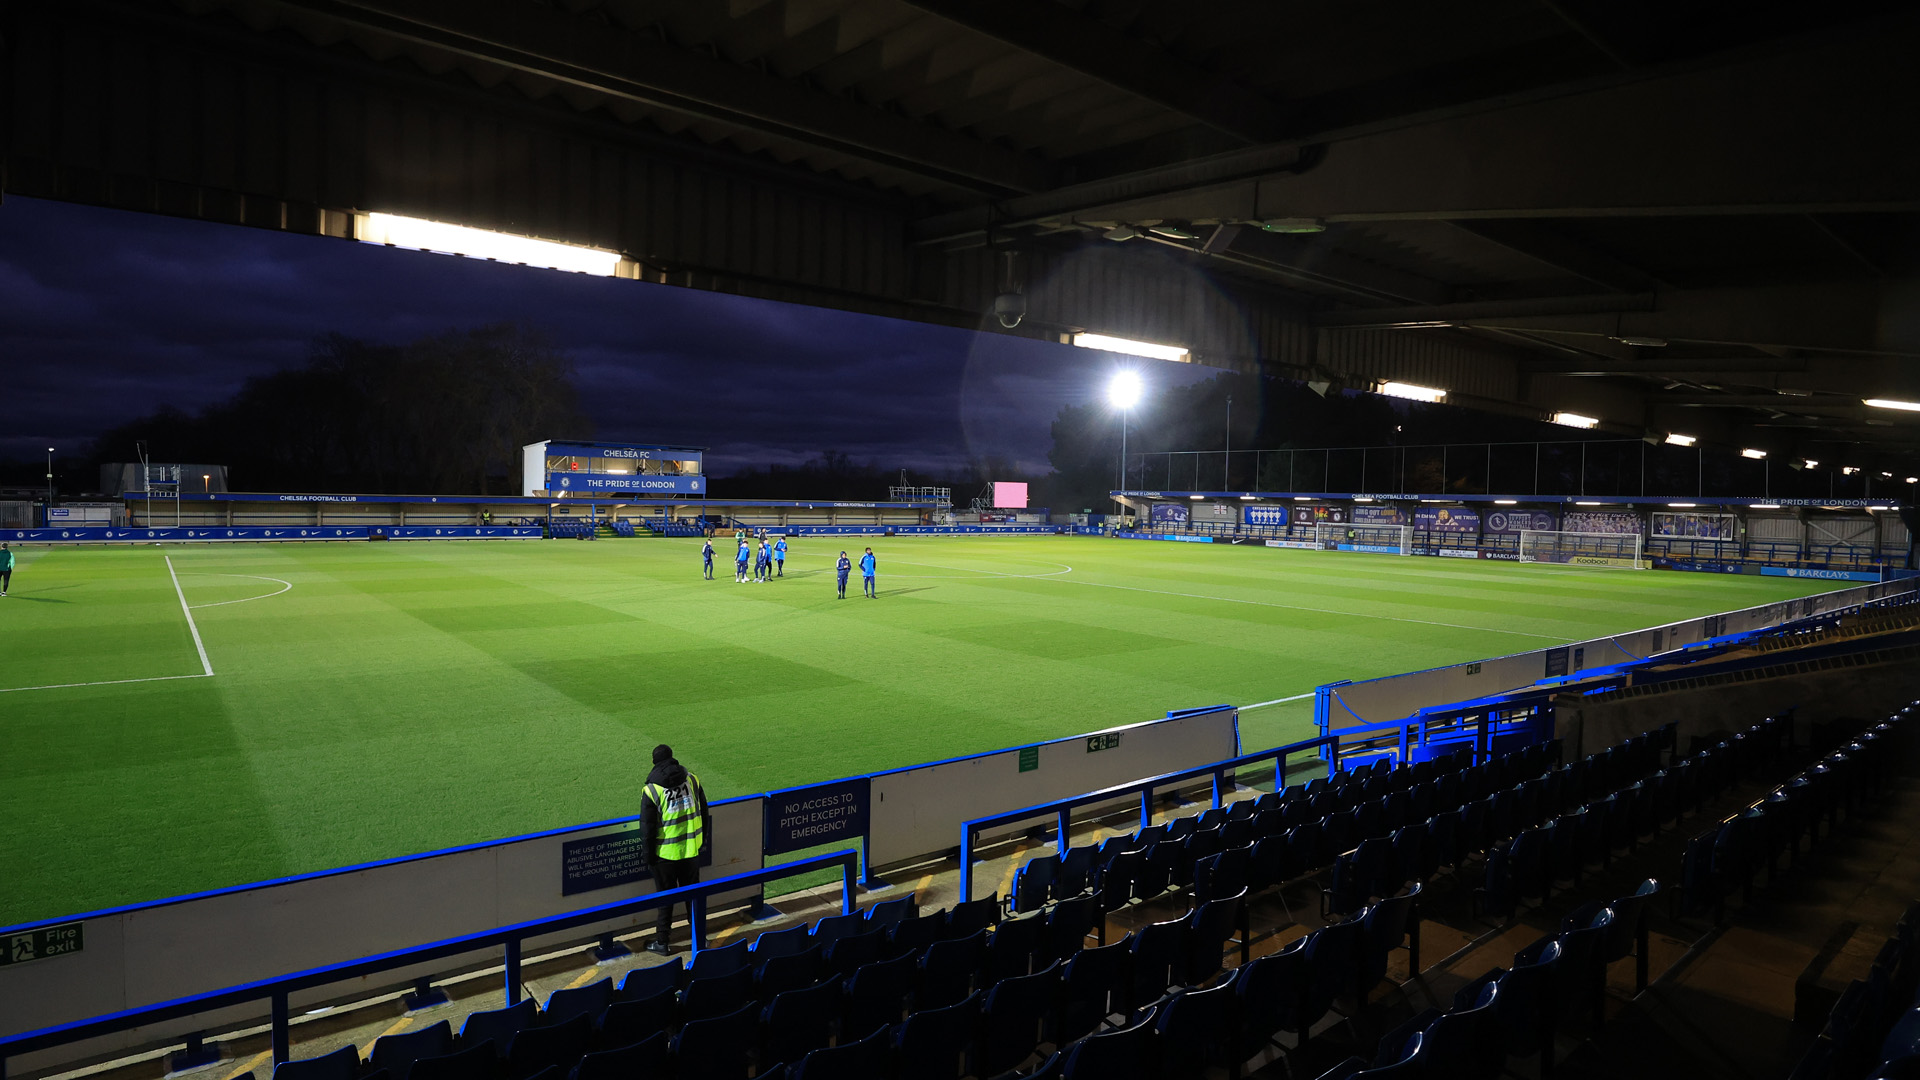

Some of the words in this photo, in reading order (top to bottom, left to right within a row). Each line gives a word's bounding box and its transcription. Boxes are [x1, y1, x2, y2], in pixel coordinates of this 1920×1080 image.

[603, 449, 639, 458] CHELSEA
[640, 451, 650, 459] FC
[587, 479, 603, 487] THE
[605, 480, 630, 488] PRIDE
[641, 481, 675, 489] LONDON
[1799, 569, 1850, 579] BARCLAYS
[665, 783, 690, 801] 221
[785, 803, 800, 814] NO
[802, 796, 839, 810] ACCESS
[841, 793, 853, 803] TO
[780, 815, 809, 829] PITCH
[811, 807, 846, 822] EXCEPT
[847, 805, 857, 815] IN
[791, 820, 847, 839] EMERGENCY
[567, 853, 593, 863] ABUSIVE
[594, 847, 628, 859] LANGUAGE
[582, 845, 595, 853] USE
[584, 859, 607, 869] RESULT
[616, 852, 639, 862] ARREST
[623, 860, 640, 868] CLUB
[604, 871, 617, 879] ONE
[618, 868, 628, 876] OR
[629, 865, 646, 874] MORE
[46, 928, 77, 942] Fire
[46, 940, 76, 955] exit
